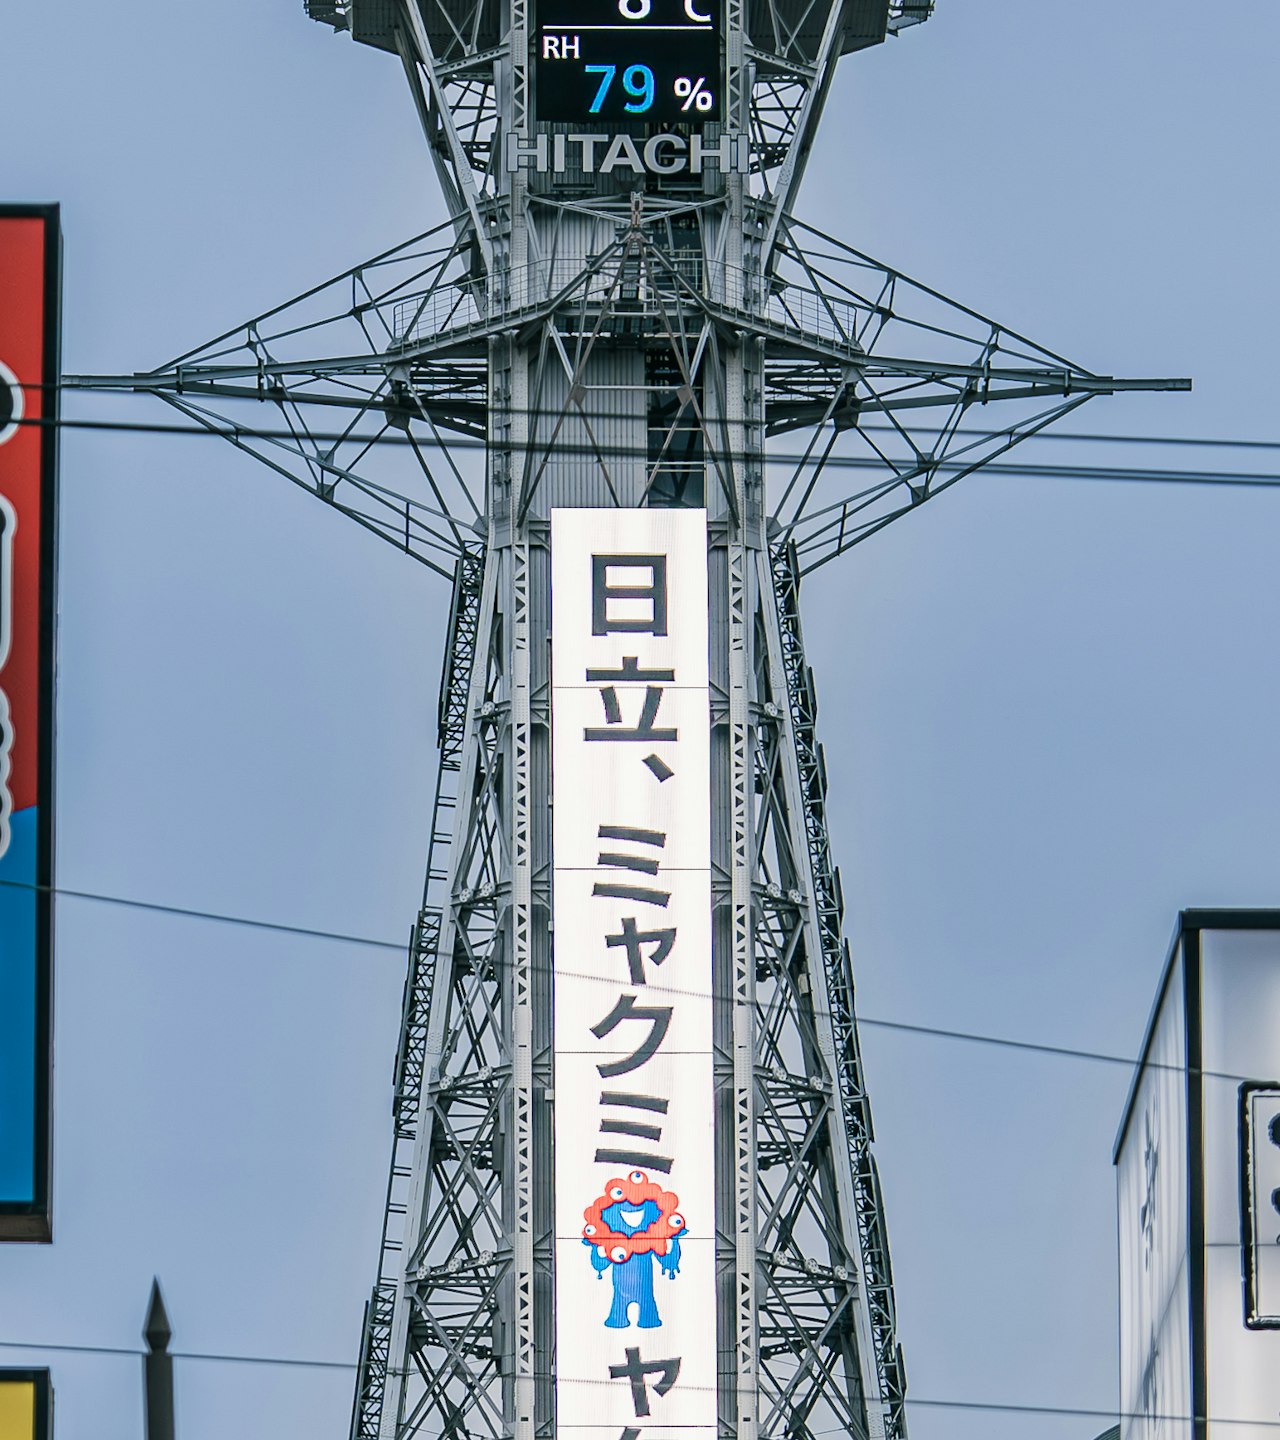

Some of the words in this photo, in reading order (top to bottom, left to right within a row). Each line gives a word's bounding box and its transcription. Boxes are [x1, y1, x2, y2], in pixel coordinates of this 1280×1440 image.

[543, 36, 580, 60] RH
[584, 64, 655, 114] 79
[674, 77, 712, 112] %
[505, 132, 749, 175] HITACHI
